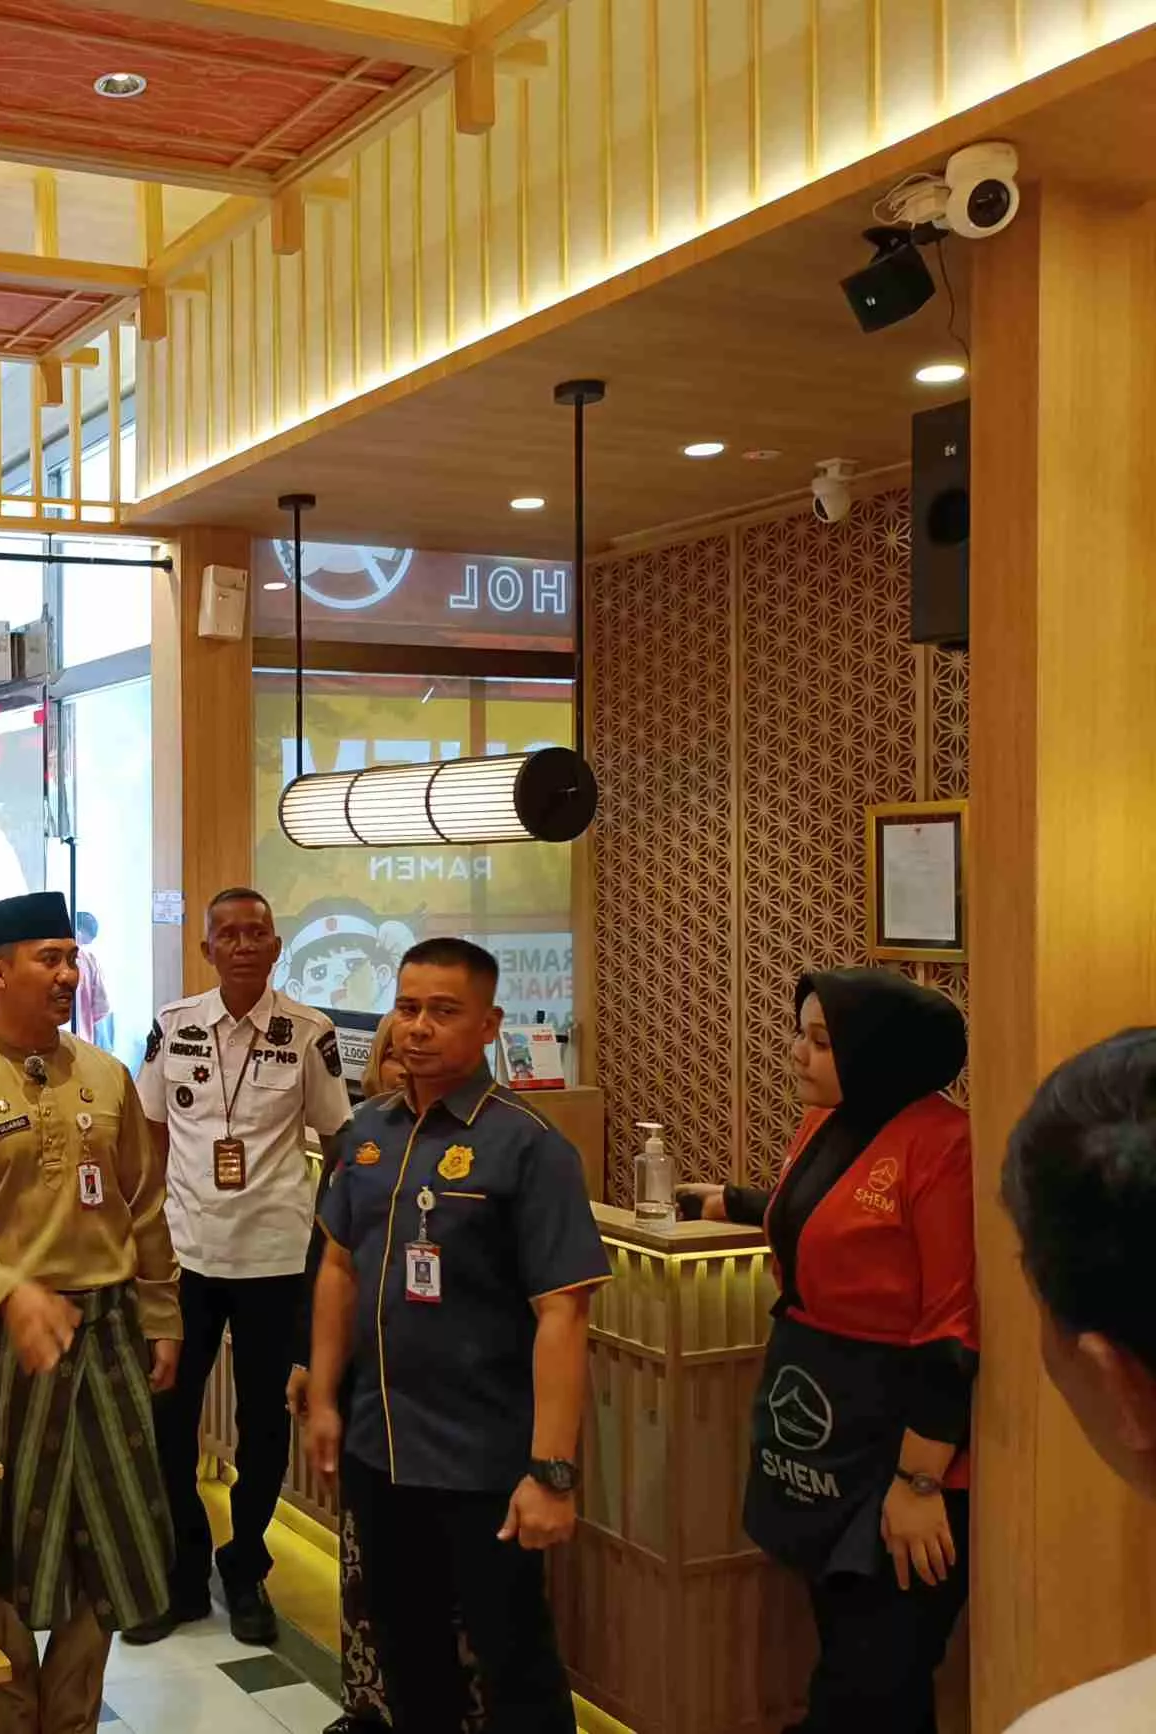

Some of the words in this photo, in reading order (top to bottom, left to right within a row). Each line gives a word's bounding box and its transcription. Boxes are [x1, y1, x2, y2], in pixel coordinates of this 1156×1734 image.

[252, 1049, 298, 1064] PPNS
[853, 1187, 895, 1213] SHEM
[761, 1448, 842, 1499] SHEM
